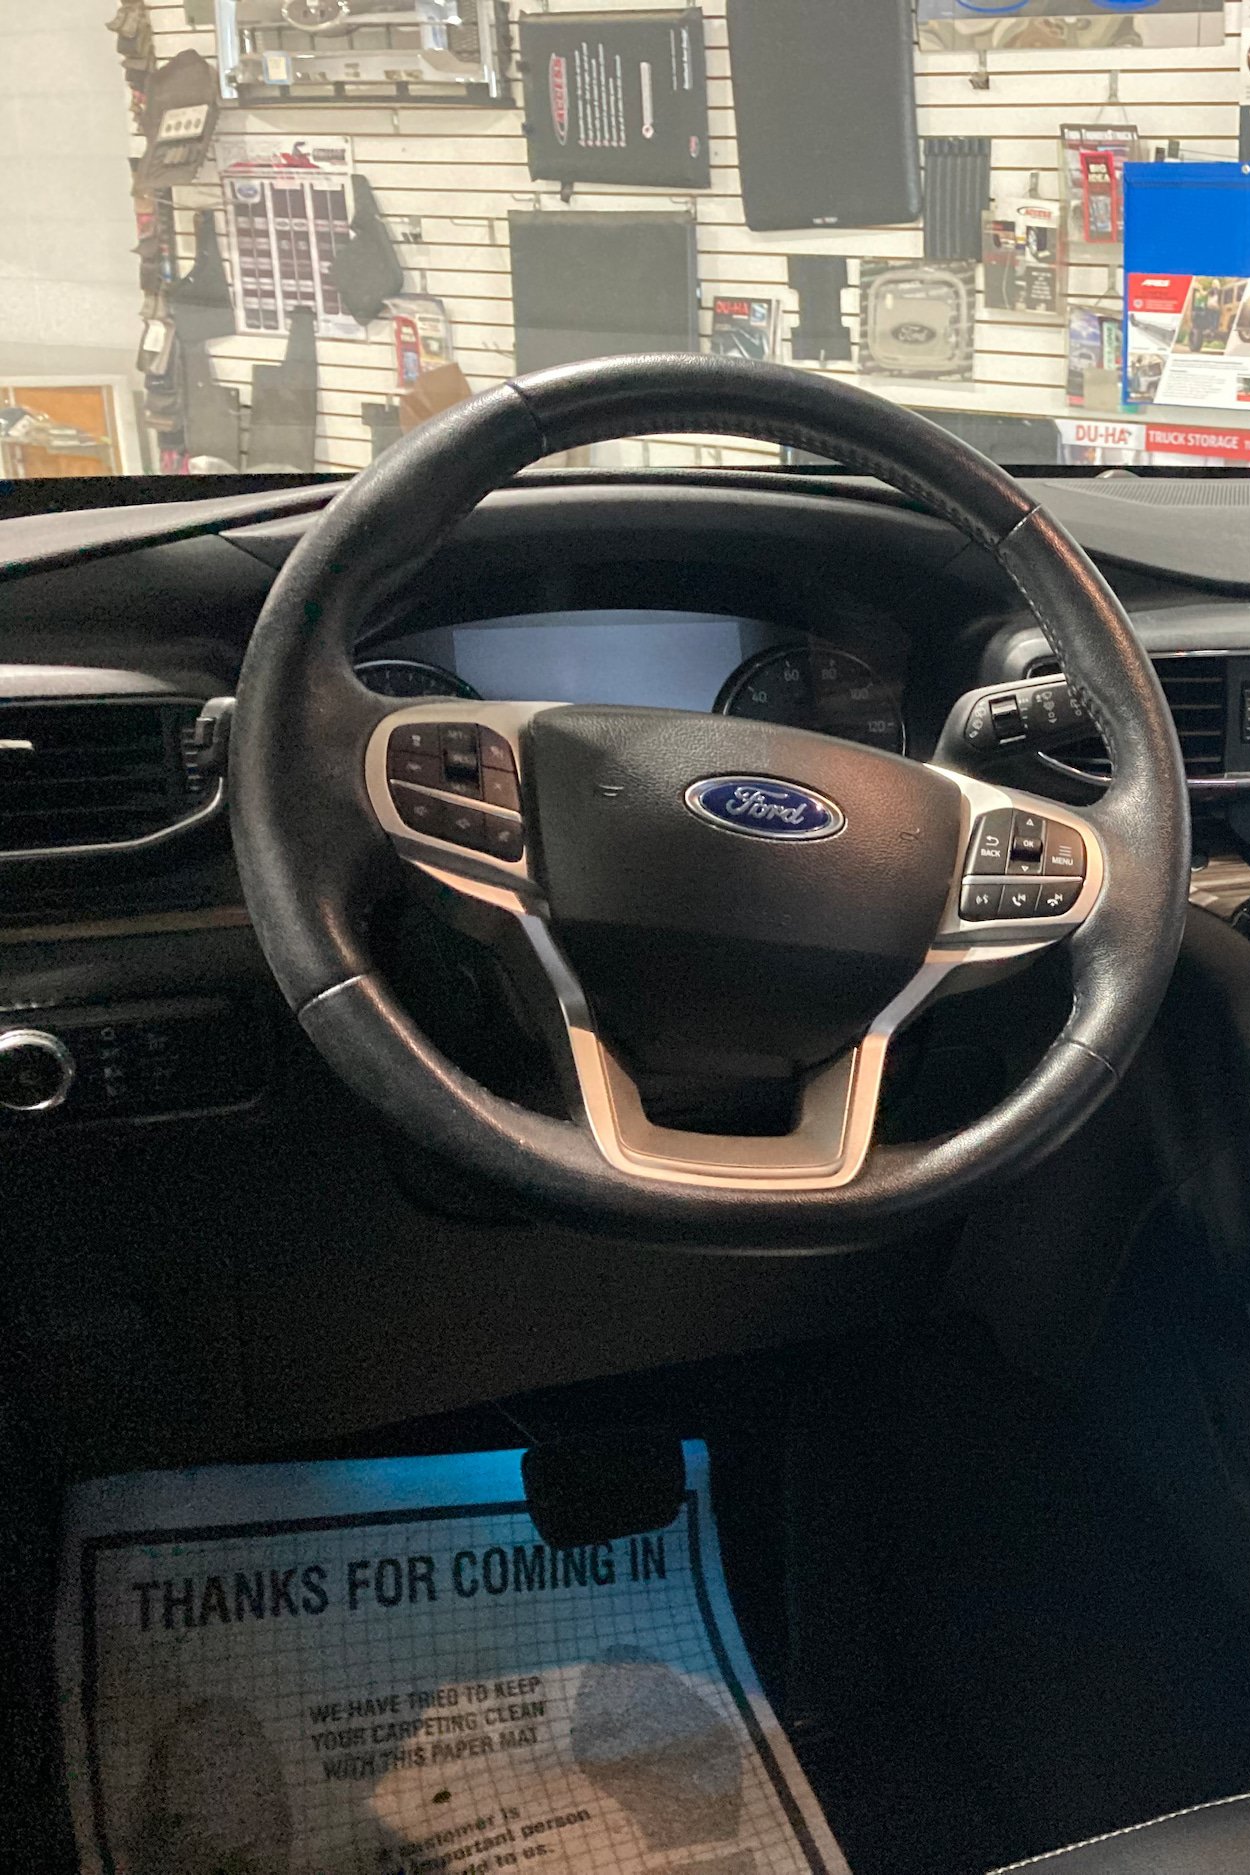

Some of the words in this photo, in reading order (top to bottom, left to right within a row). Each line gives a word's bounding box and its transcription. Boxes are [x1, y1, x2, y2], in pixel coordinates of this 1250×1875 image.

[553, 56, 567, 123] ACCESS
[715, 301, 749, 316] DU-HA
[1075, 424, 1128, 445] DU-HA
[1148, 430, 1186, 446] TRUCK
[1188, 433, 1239, 449] STORAGE
[784, 669, 799, 682] 60
[821, 668, 837, 680] 80
[867, 721, 886, 733] 120
[726, 785, 807, 825] Ford
[981, 848, 1001, 857] BACK
[1023, 840, 1034, 848] OK
[1052, 856, 1074, 866] MENU
[131, 1563, 330, 1632] THANKS
[346, 1555, 438, 1611] FOR
[451, 1540, 616, 1598] COMING
[629, 1536, 667, 1583] IN
[309, 1700, 344, 1724] WE
[347, 1695, 401, 1719] HAVE
[407, 1687, 459, 1710] TRIED
[465, 1684, 488, 1703] TO
[493, 1676, 541, 1698] KEEP
[311, 1727, 367, 1751] YOUR
[372, 1711, 479, 1745] CARPETING
[484, 1701, 546, 1727] CLEAN
[380, 1746, 426, 1771] THIS
[430, 1734, 495, 1763] PAPER
[498, 1727, 539, 1750] MAT
[500, 1807, 520, 1821] is
[520, 1807, 592, 1839] person
[493, 1850, 518, 1868] to
[522, 1843, 555, 1860] us.
